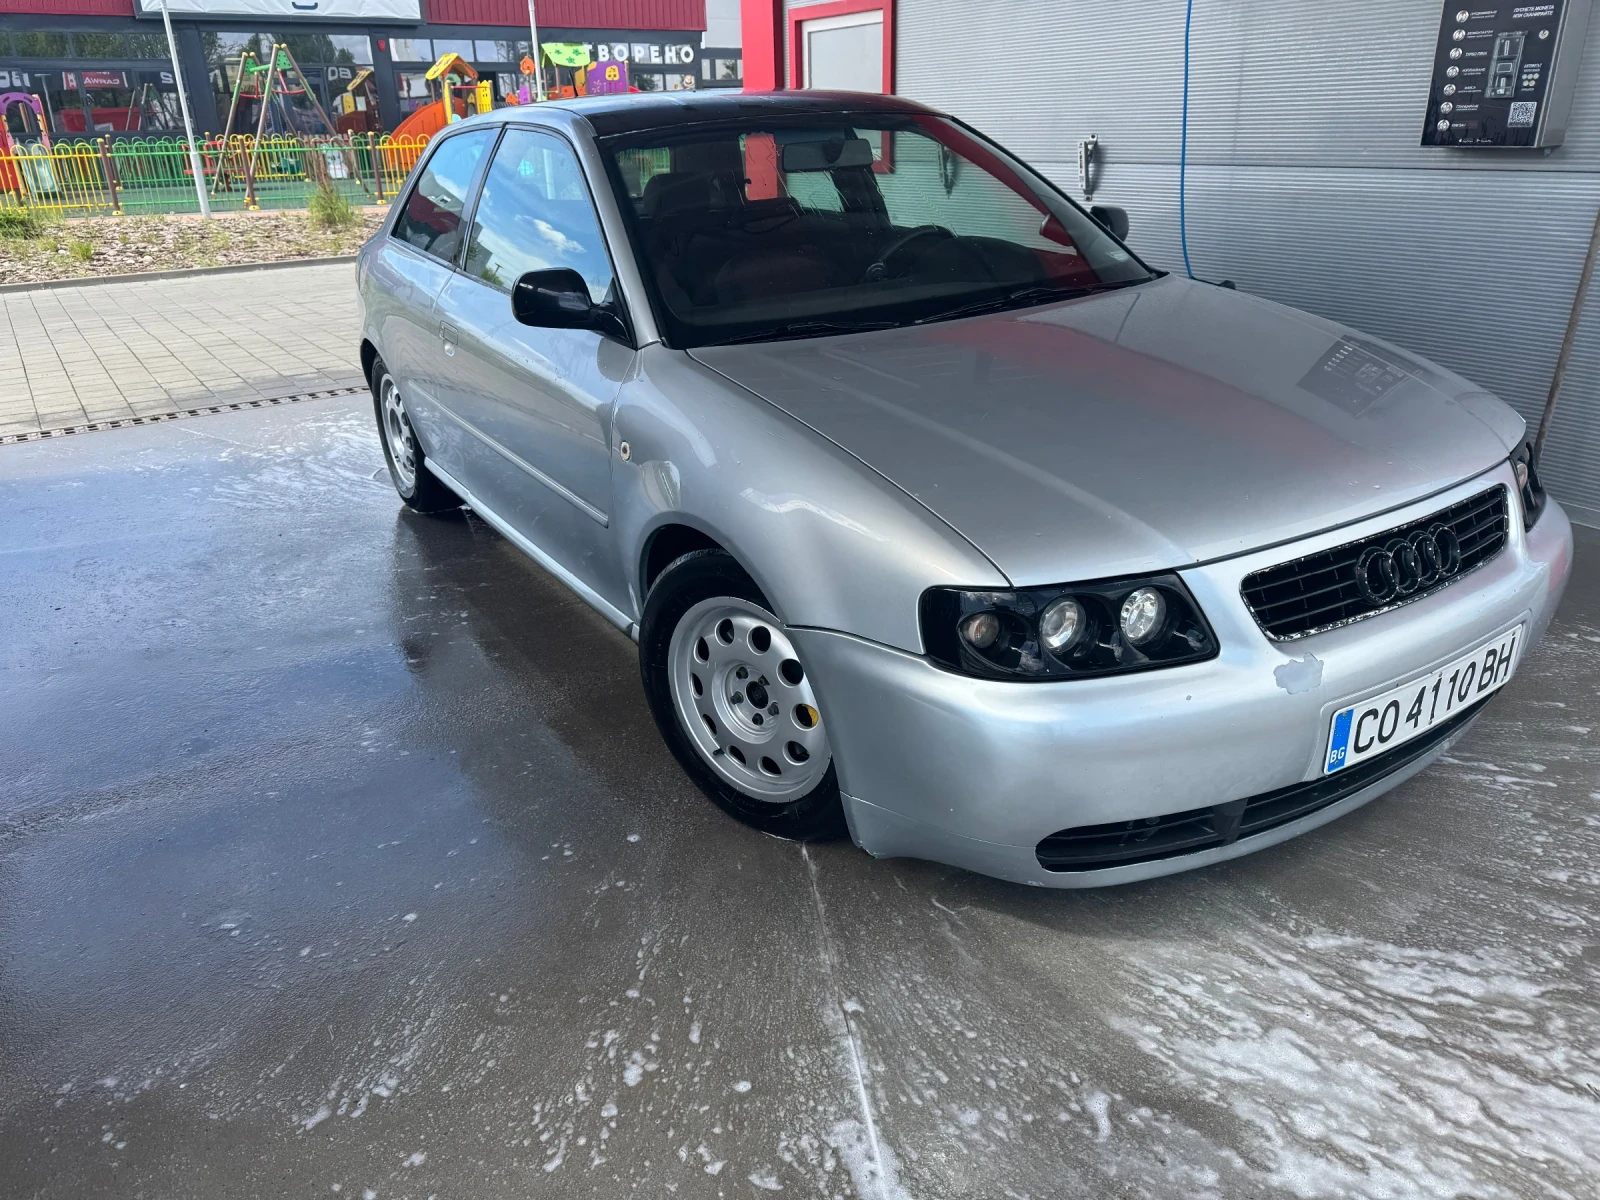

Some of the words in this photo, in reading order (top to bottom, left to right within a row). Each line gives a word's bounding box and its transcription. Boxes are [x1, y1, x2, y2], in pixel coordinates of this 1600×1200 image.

[1353, 700, 1400, 754] CO
[1405, 661, 1477, 729] 4110
[1477, 635, 1516, 693] BH
[1330, 746, 1346, 763] BG
